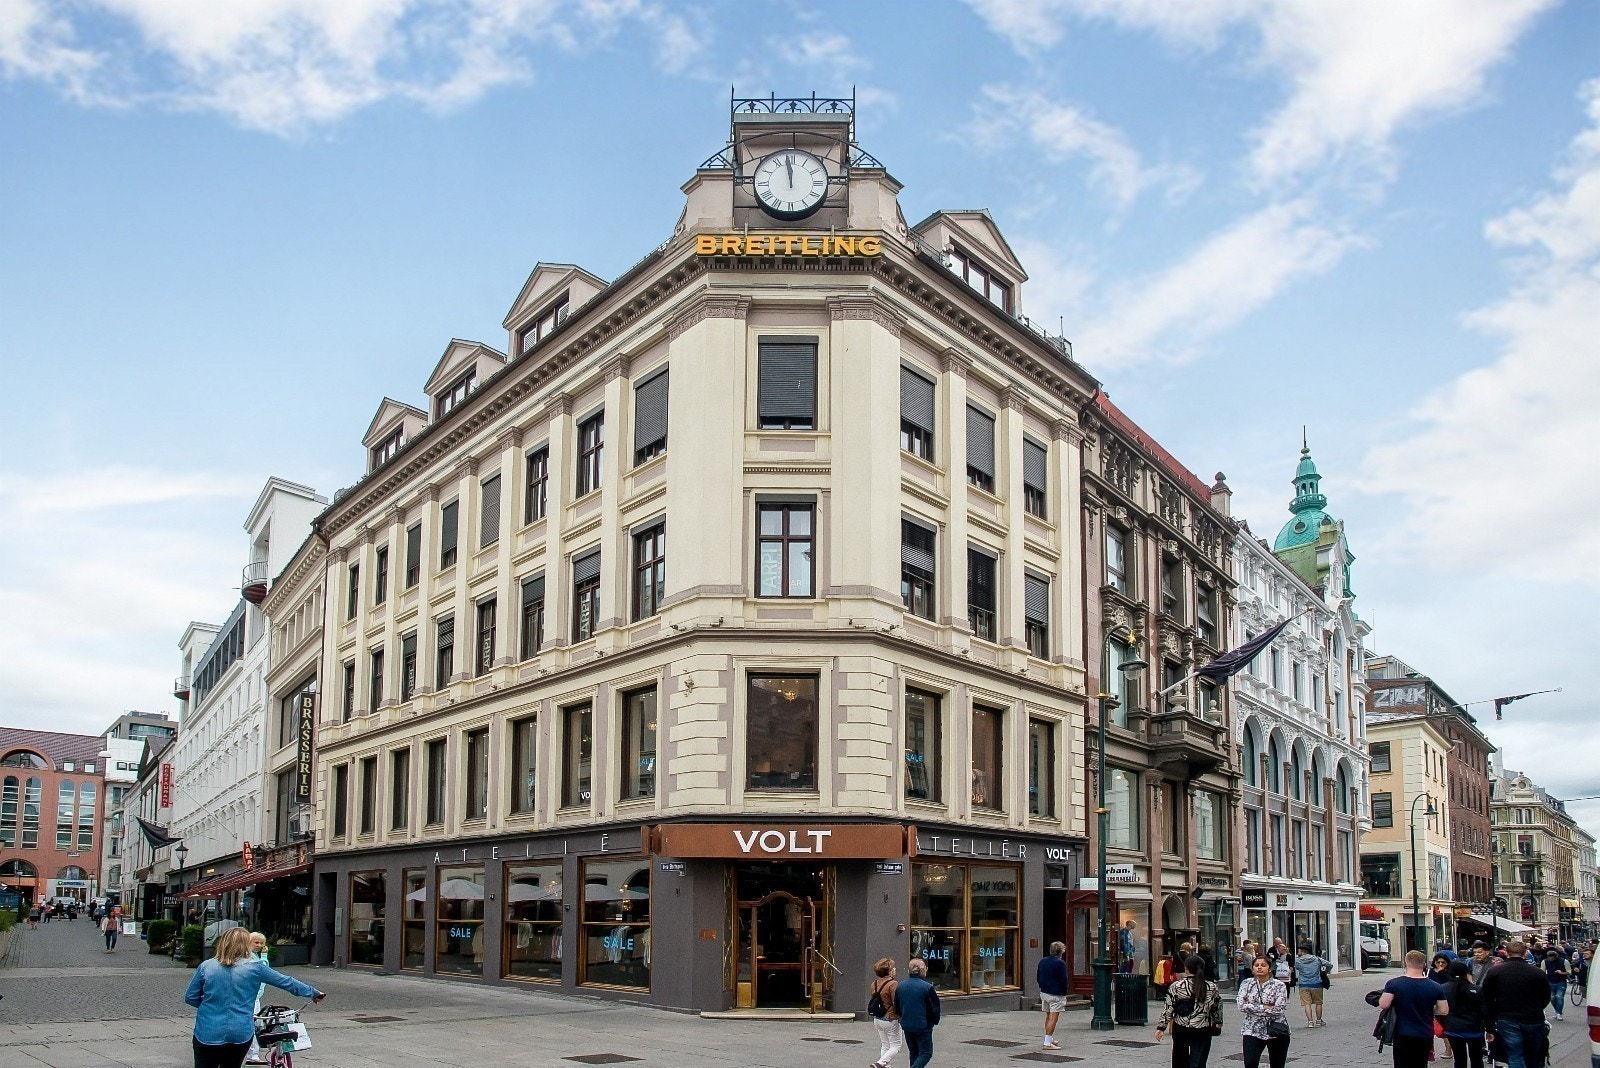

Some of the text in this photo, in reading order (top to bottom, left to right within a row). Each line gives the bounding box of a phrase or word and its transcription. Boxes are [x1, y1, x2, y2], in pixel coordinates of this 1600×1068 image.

[697, 235, 882, 256] BREITLING
[300, 697, 313, 797] BRASSERIE
[732, 829, 832, 853] VOLT
[1046, 847, 1071, 861] VOLT
[1245, 894, 1264, 902] BOSS
[450, 927, 471, 938] SALE
[603, 936, 634, 950] SALE
[922, 949, 949, 959] SALE
[979, 947, 1003, 957] SALE
